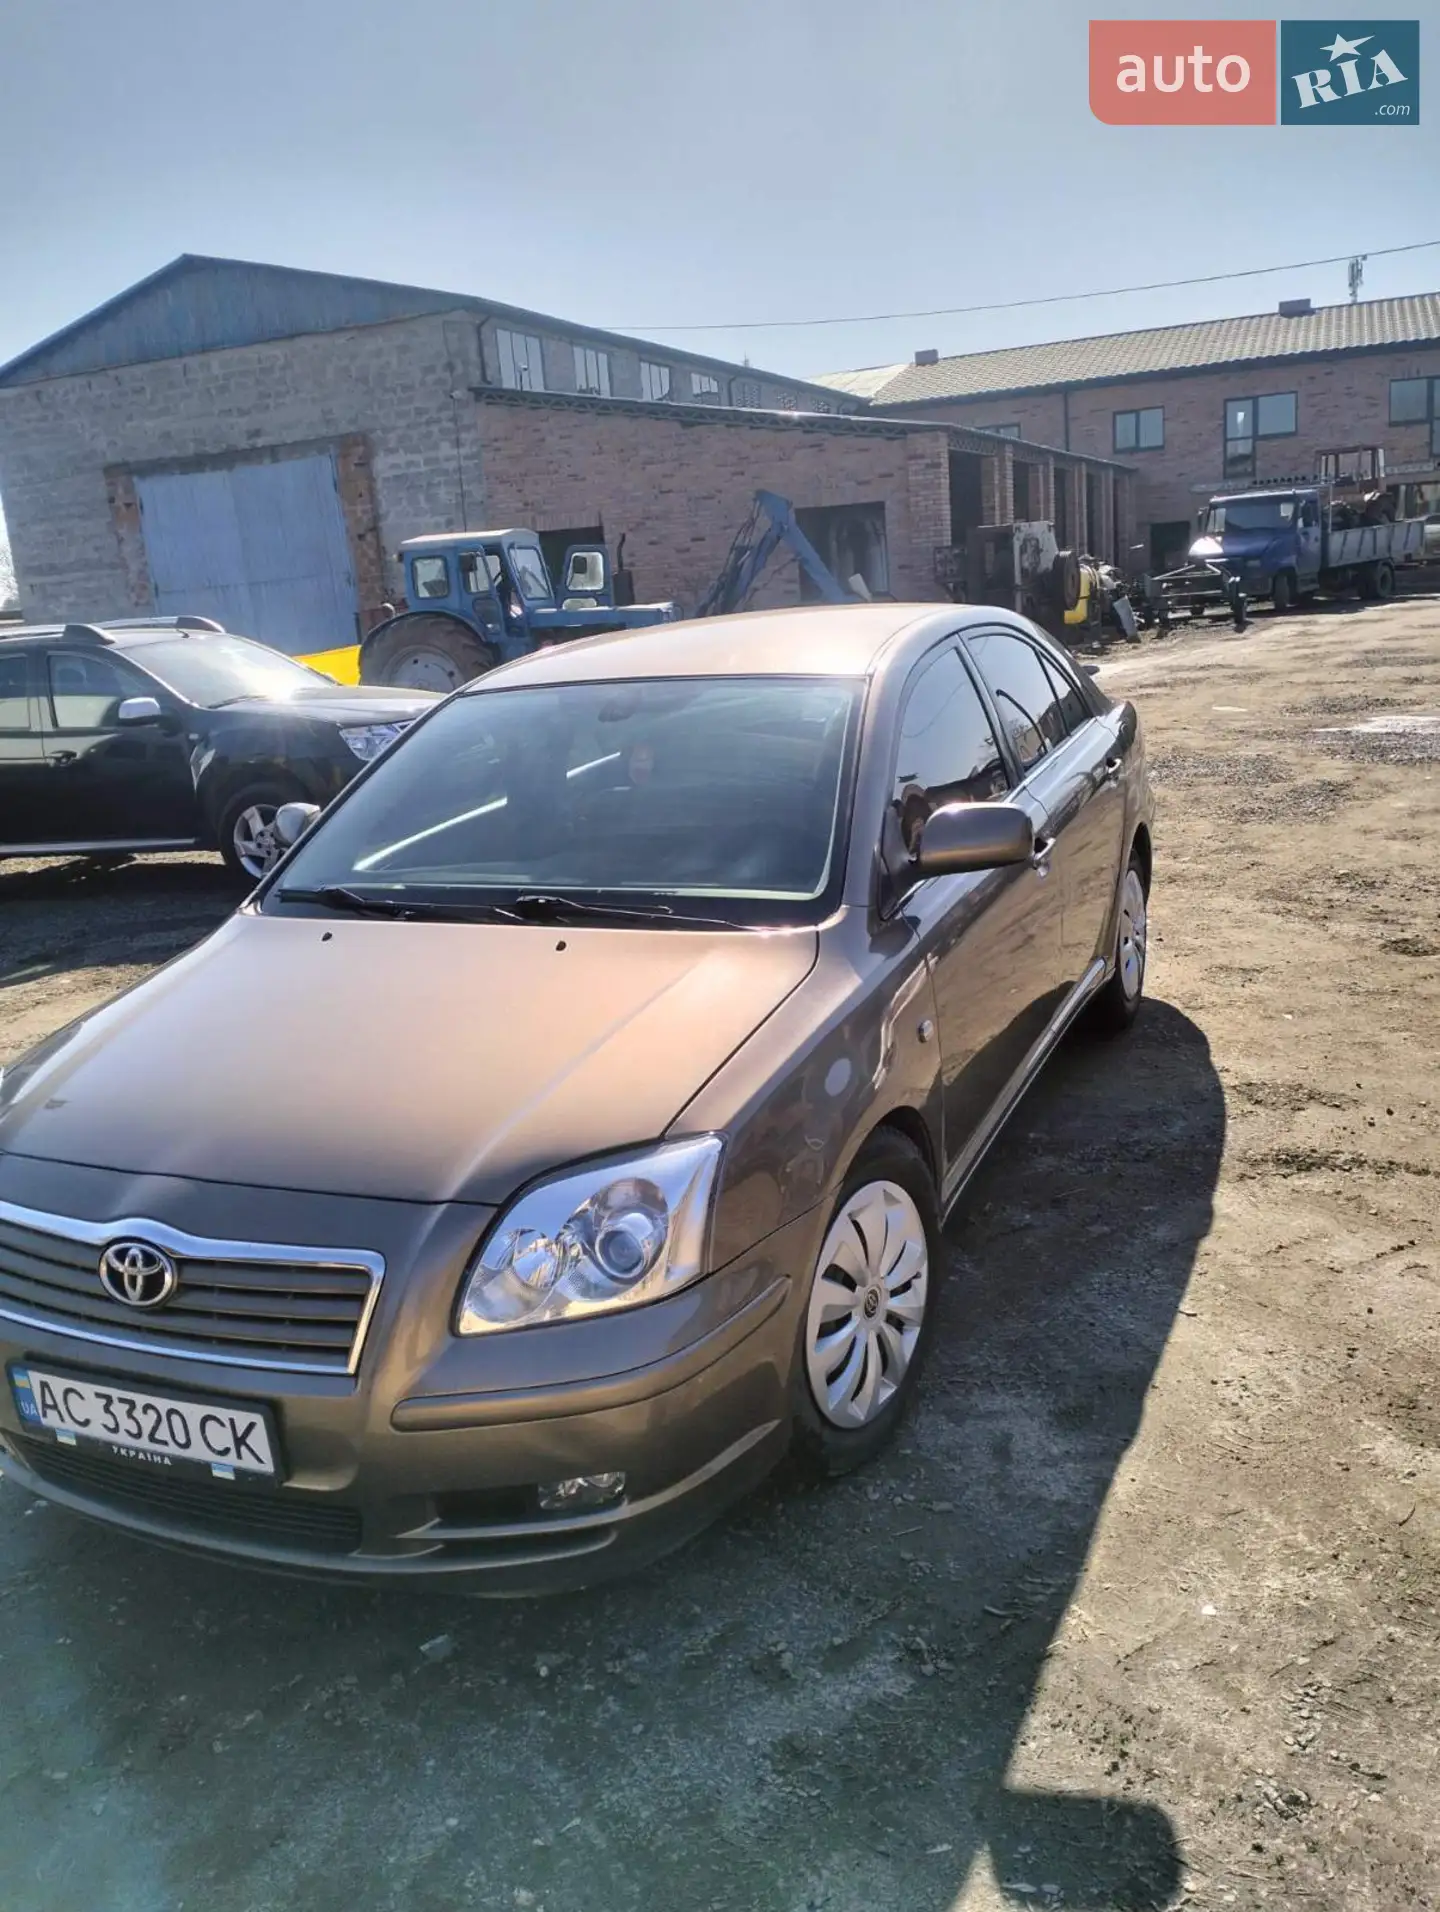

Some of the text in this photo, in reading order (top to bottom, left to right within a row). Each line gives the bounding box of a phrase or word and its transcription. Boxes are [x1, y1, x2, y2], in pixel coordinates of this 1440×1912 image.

[20, 1400, 38, 1416] UA
[39, 1380, 266, 1465] AC 3320 CK
